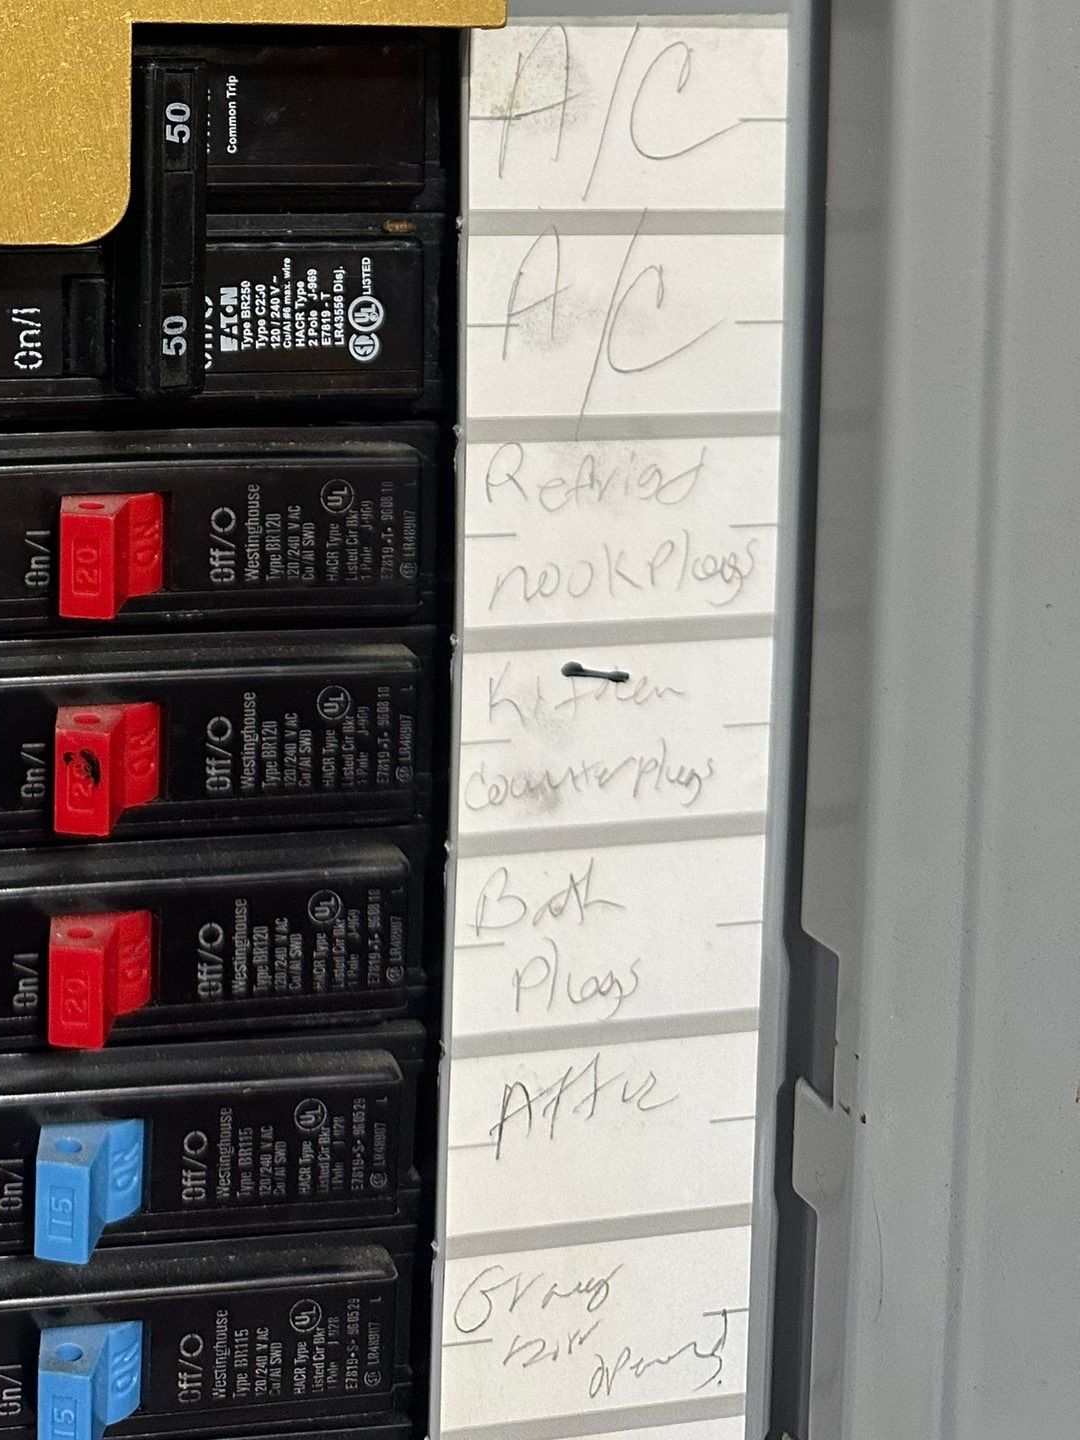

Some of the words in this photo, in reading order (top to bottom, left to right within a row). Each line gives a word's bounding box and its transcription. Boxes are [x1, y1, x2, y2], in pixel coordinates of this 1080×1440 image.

[226, 76, 239, 98] Trip
[165, 102, 191, 143] 50
[226, 101, 237, 154] Common
[497, 22, 748, 203] A/C
[282, 258, 293, 279] wire
[306, 269, 318, 300] J-969
[360, 257, 371, 295] LISTED
[241, 281, 252, 319] BR250
[294, 281, 307, 310] Type
[162, 315, 188, 356] 50
[220, 286, 238, 351] EATON
[242, 322, 255, 350] Type
[256, 321, 270, 349] Type
[294, 313, 305, 347] HACR
[307, 310, 318, 336] Pole
[320, 309, 331, 345] E7819
[501, 205, 727, 443] A/C
[245, 484, 263, 582] Westinghouse
[265, 513, 282, 551] BR120
[265, 553, 284, 580] Type
[241, 691, 259, 787] Westinghouse
[262, 720, 279, 758] BR120
[263, 760, 282, 787] Type
[232, 898, 251, 993] Westinghouse
[253, 926, 270, 963] BR120
[255, 966, 273, 991] Type
[216, 1107, 236, 1198] Westinghouse
[236, 1127, 253, 1167] BR115
[237, 1171, 256, 1196] Type
[213, 1309, 231, 1398] Westinghouse
[233, 1328, 250, 1367] BR115
[234, 1373, 252, 1397] Type
